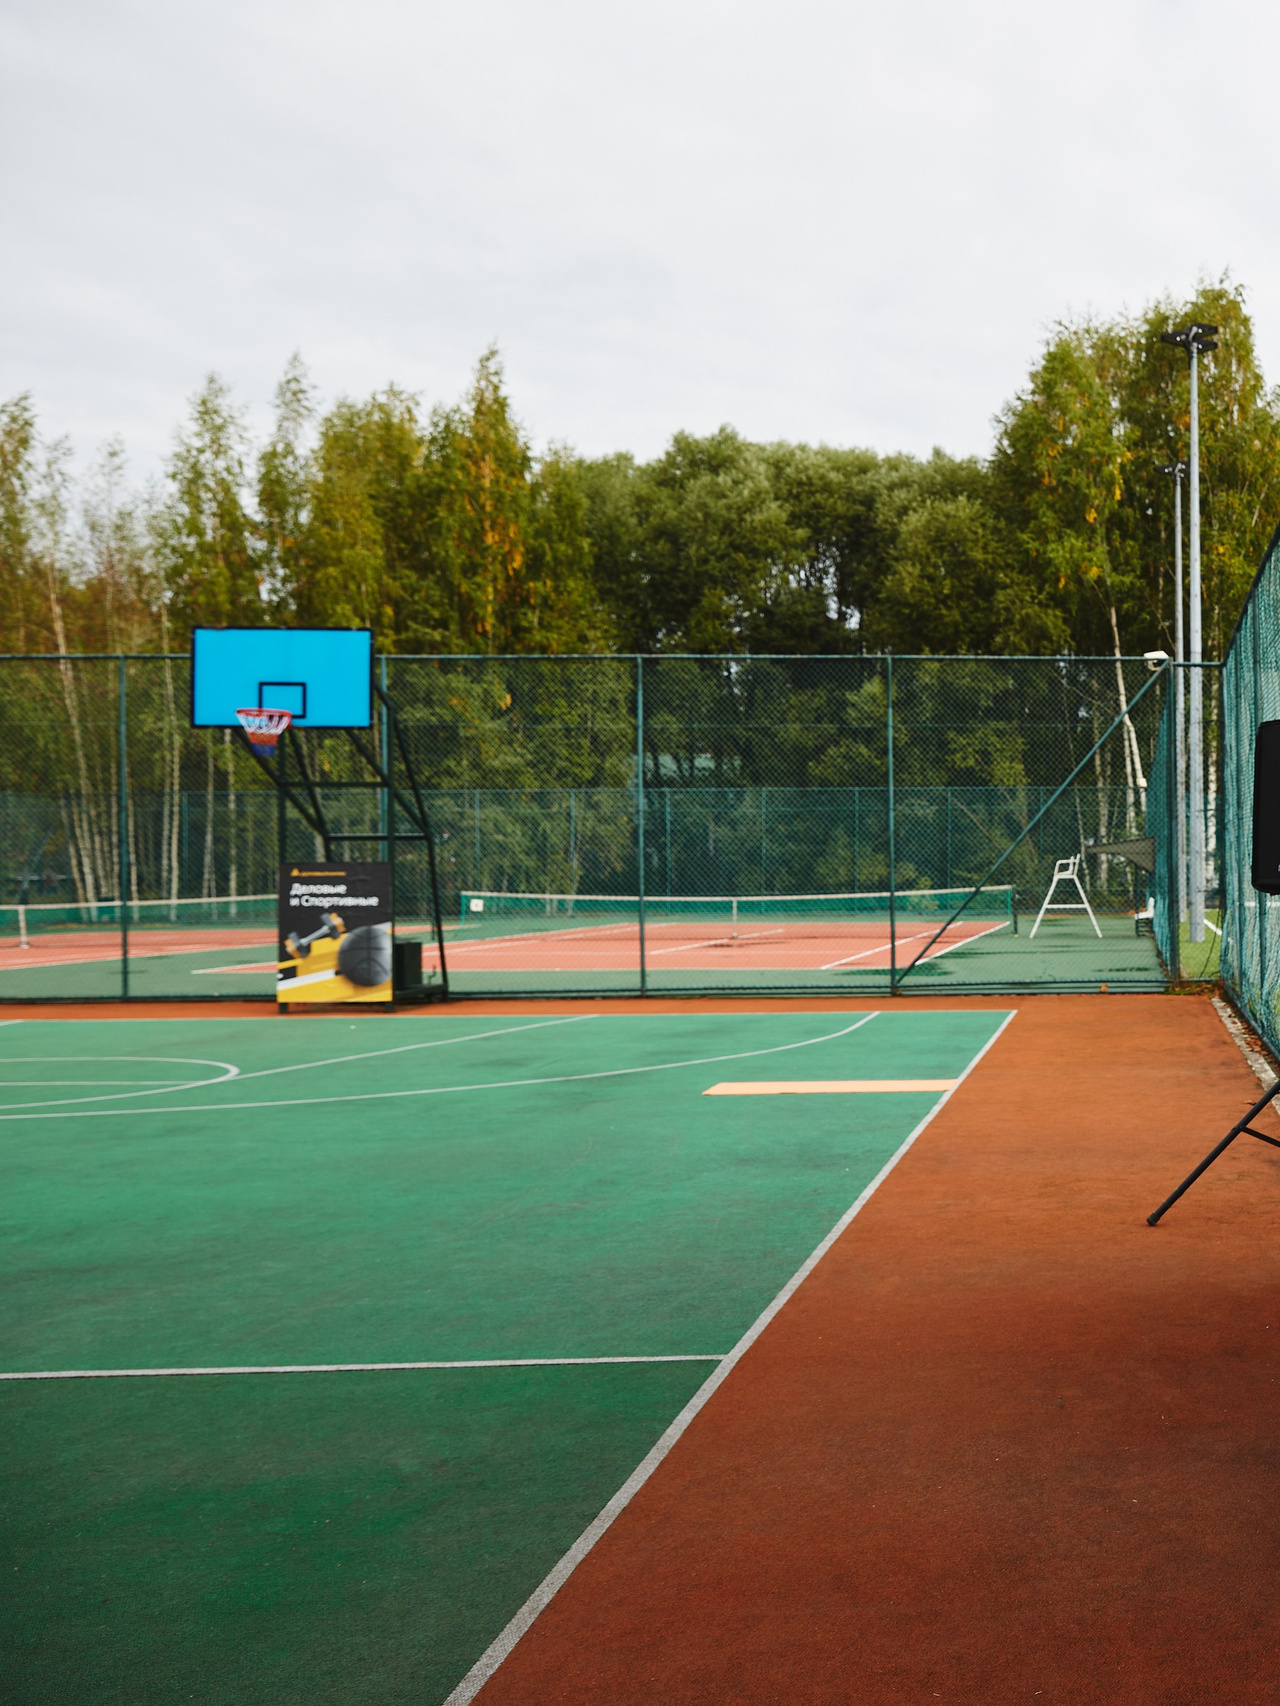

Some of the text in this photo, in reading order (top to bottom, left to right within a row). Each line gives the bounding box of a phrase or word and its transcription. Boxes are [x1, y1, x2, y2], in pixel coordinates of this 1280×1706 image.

[290, 883, 347, 896] Деловые
[290, 895, 379, 909] и Спортивные
